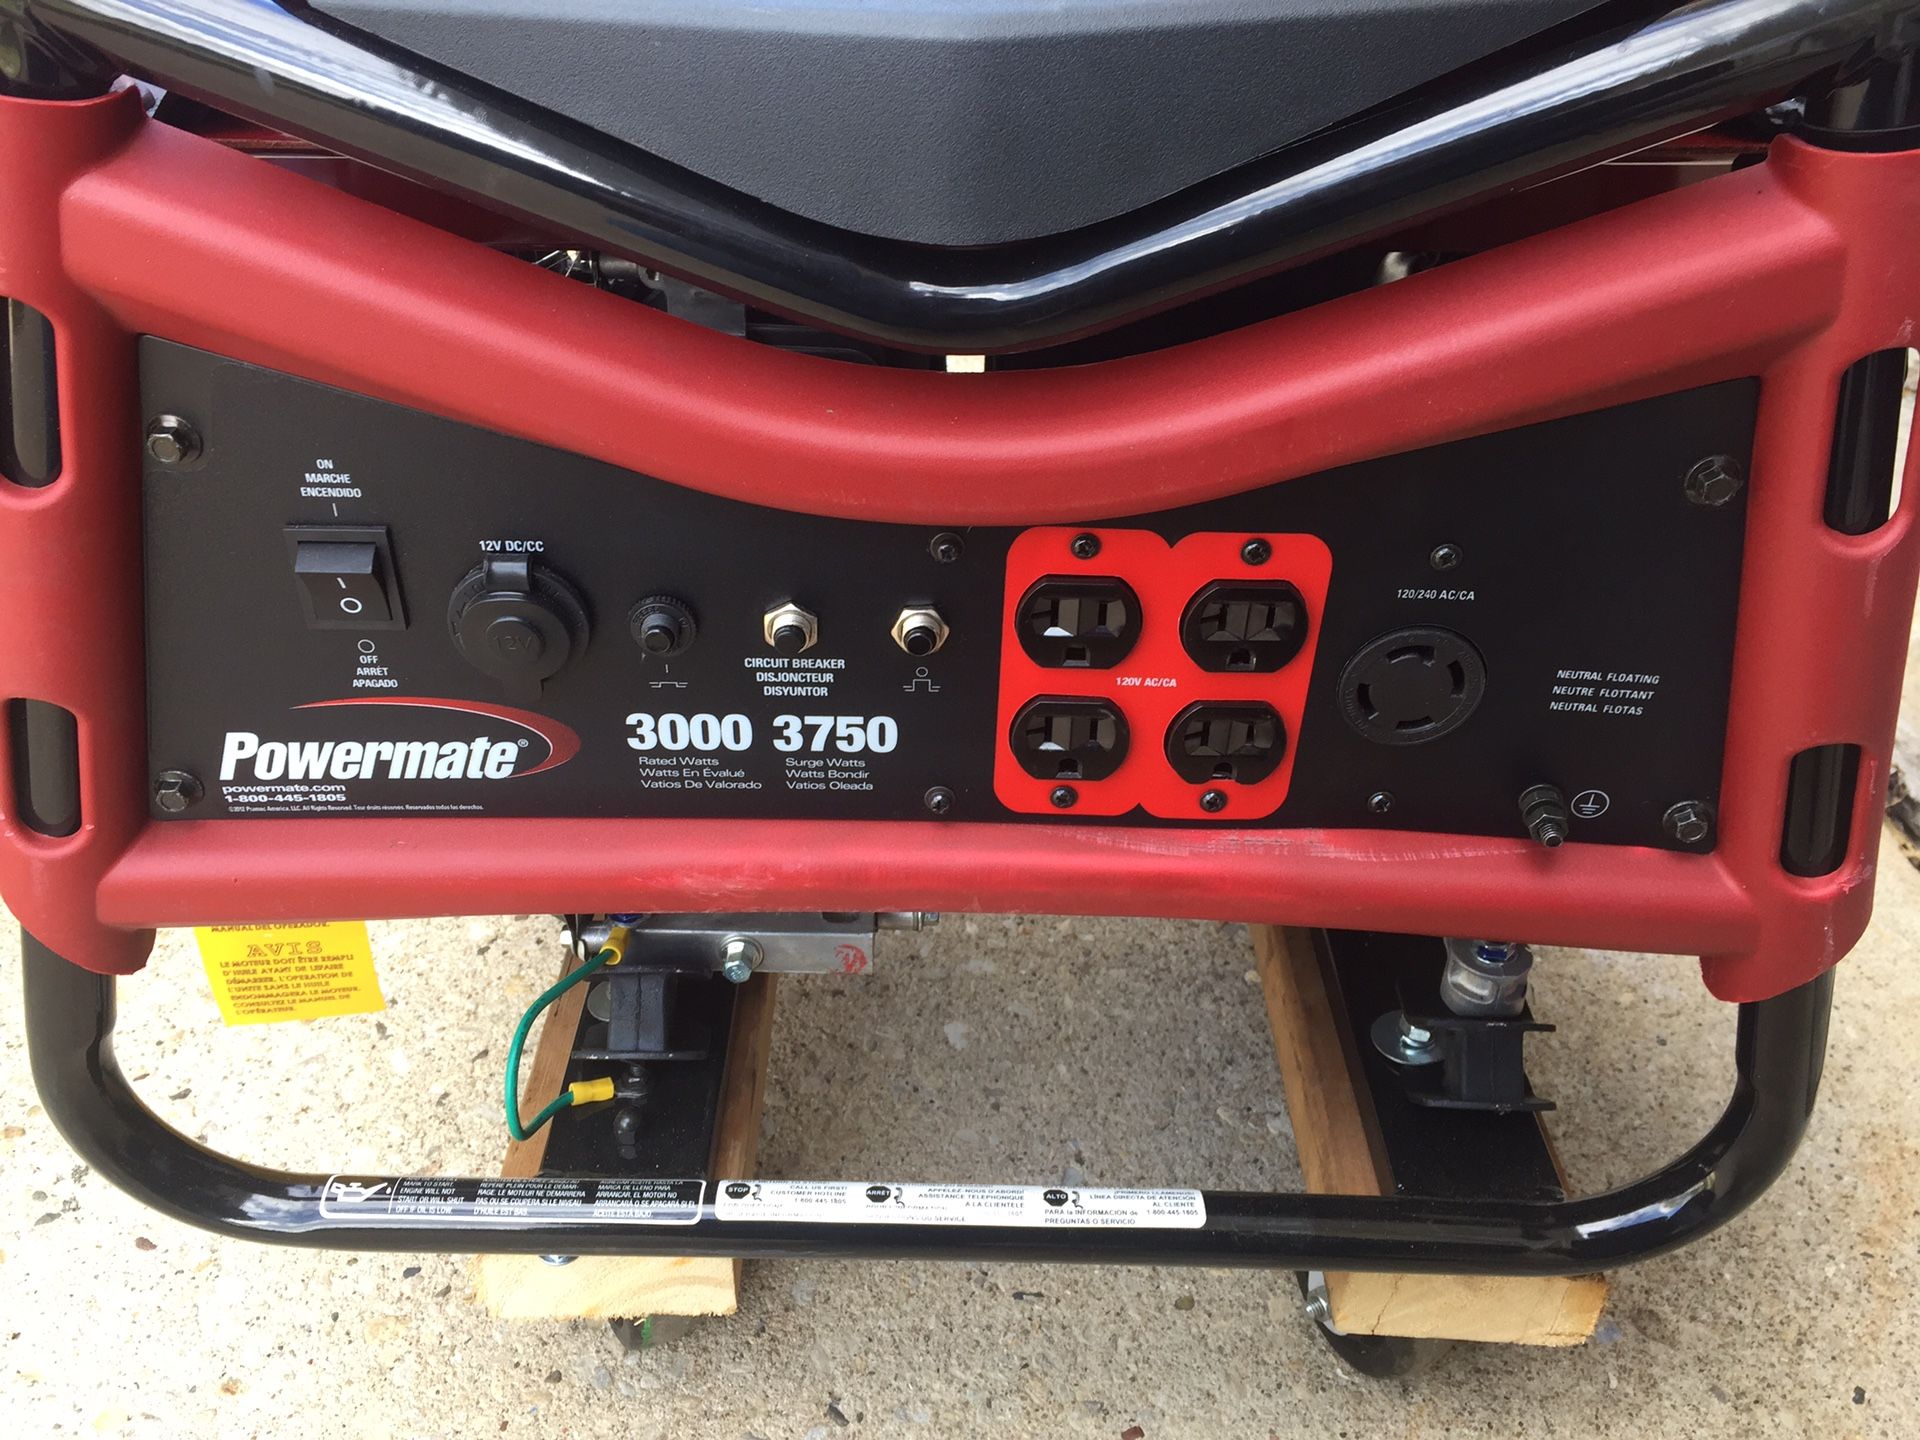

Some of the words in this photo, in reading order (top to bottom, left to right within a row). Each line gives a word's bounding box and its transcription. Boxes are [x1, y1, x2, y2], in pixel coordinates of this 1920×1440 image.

[316, 459, 334, 469] ON
[304, 473, 352, 484] MARCHE
[300, 487, 362, 498] ENCENDIDO
[479, 540, 501, 552] 12V
[505, 540, 544, 552] DC/CC
[1397, 589, 1437, 600] 120/240
[1439, 590, 1475, 601] AC/CA
[359, 655, 379, 664] OFF
[744, 657, 789, 668] CIRCUIT
[792, 658, 845, 670] BREAKER
[756, 672, 834, 683] DISJONCTEUR
[1116, 677, 1142, 686] 120V
[1144, 678, 1177, 687] AC/CA
[1556, 670, 1603, 681] NEUTRAL
[1606, 672, 1660, 684] FLOATING
[352, 678, 399, 688] APAGADO
[763, 686, 829, 697] DISYUNTOR
[1552, 686, 1595, 697] NEUTRE
[1599, 688, 1655, 700] FLOTTANT
[1549, 701, 1598, 713] NEUTRAL
[1602, 704, 1644, 716] FLOTAS
[625, 713, 752, 751] 3000
[772, 714, 898, 753] 3750
[639, 756, 677, 766] Rated
[679, 756, 719, 766] Watts
[785, 757, 824, 769] Surge
[826, 758, 866, 768] Watts
[639, 768, 680, 778] Watts
[683, 768, 699, 778] En
[703, 766, 745, 778] Évalué
[785, 769, 825, 779] Watts
[828, 769, 870, 779] Bondir
[222, 784, 346, 794] powermate.com
[640, 780, 681, 789] Vatios
[685, 780, 702, 789] De
[705, 779, 762, 790] Valorado
[786, 780, 826, 790] Vatios
[829, 781, 874, 791] Oleada
[224, 793, 347, 803] 1-800-445-1805
[247, 940, 323, 958] AVIS
[232, 959, 271, 967] MOTEUR
[397, 1195, 419, 1203] START
[430, 1196, 445, 1204] WILL
[446, 1196, 464, 1204] SHUT
[475, 1197, 488, 1205] PAS
[510, 1198, 541, 1206] COUPERA
[558, 1199, 582, 1207] NIVEAU
[396, 1205, 409, 1213] OFF
[428, 1206, 435, 1214] IS
[500, 1207, 513, 1215] EST
